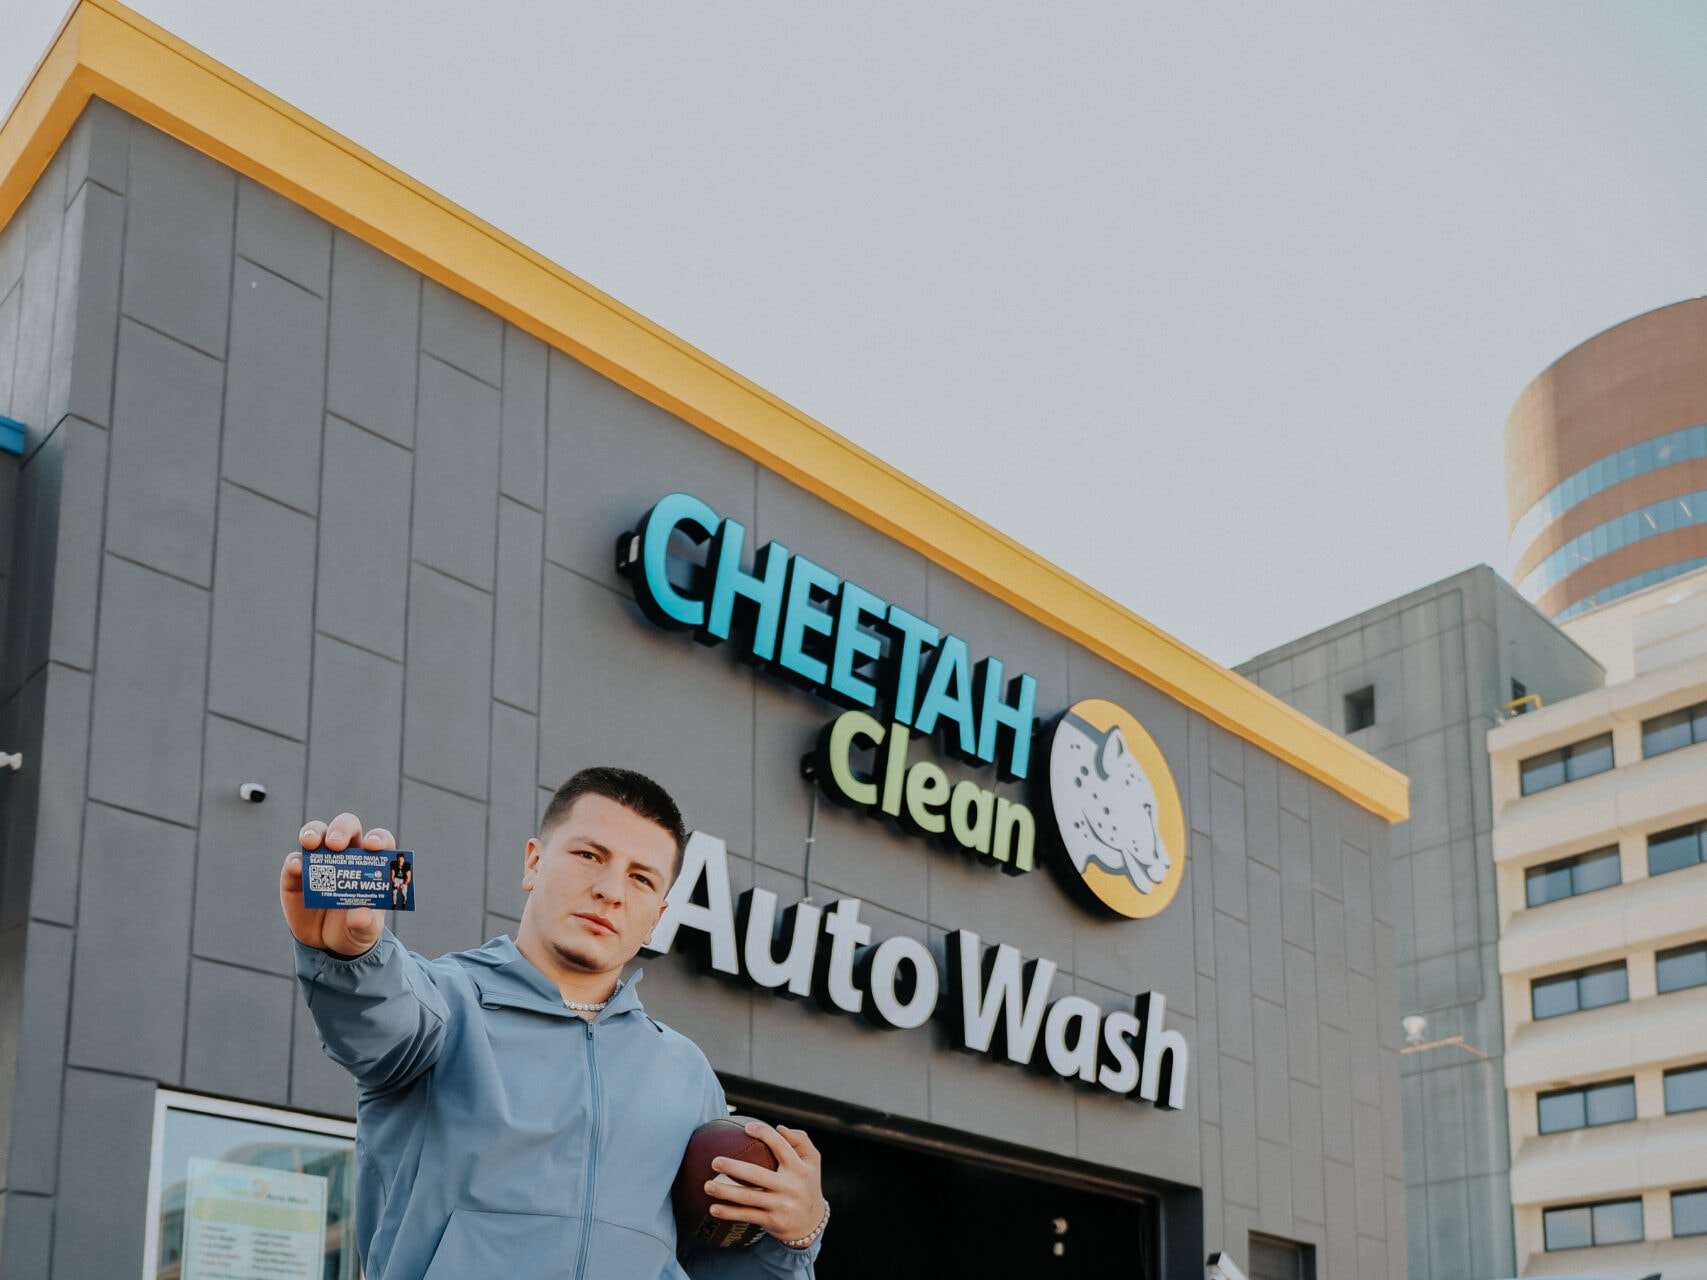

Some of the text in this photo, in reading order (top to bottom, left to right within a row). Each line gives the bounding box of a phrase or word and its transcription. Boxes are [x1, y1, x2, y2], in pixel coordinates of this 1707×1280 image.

[643, 491, 1038, 779] CHEETAH
[829, 709, 1037, 873] Clean
[337, 869, 362, 880] FREE
[337, 880, 390, 891] CAR WASH
[641, 830, 1189, 1111] Auto Wash
